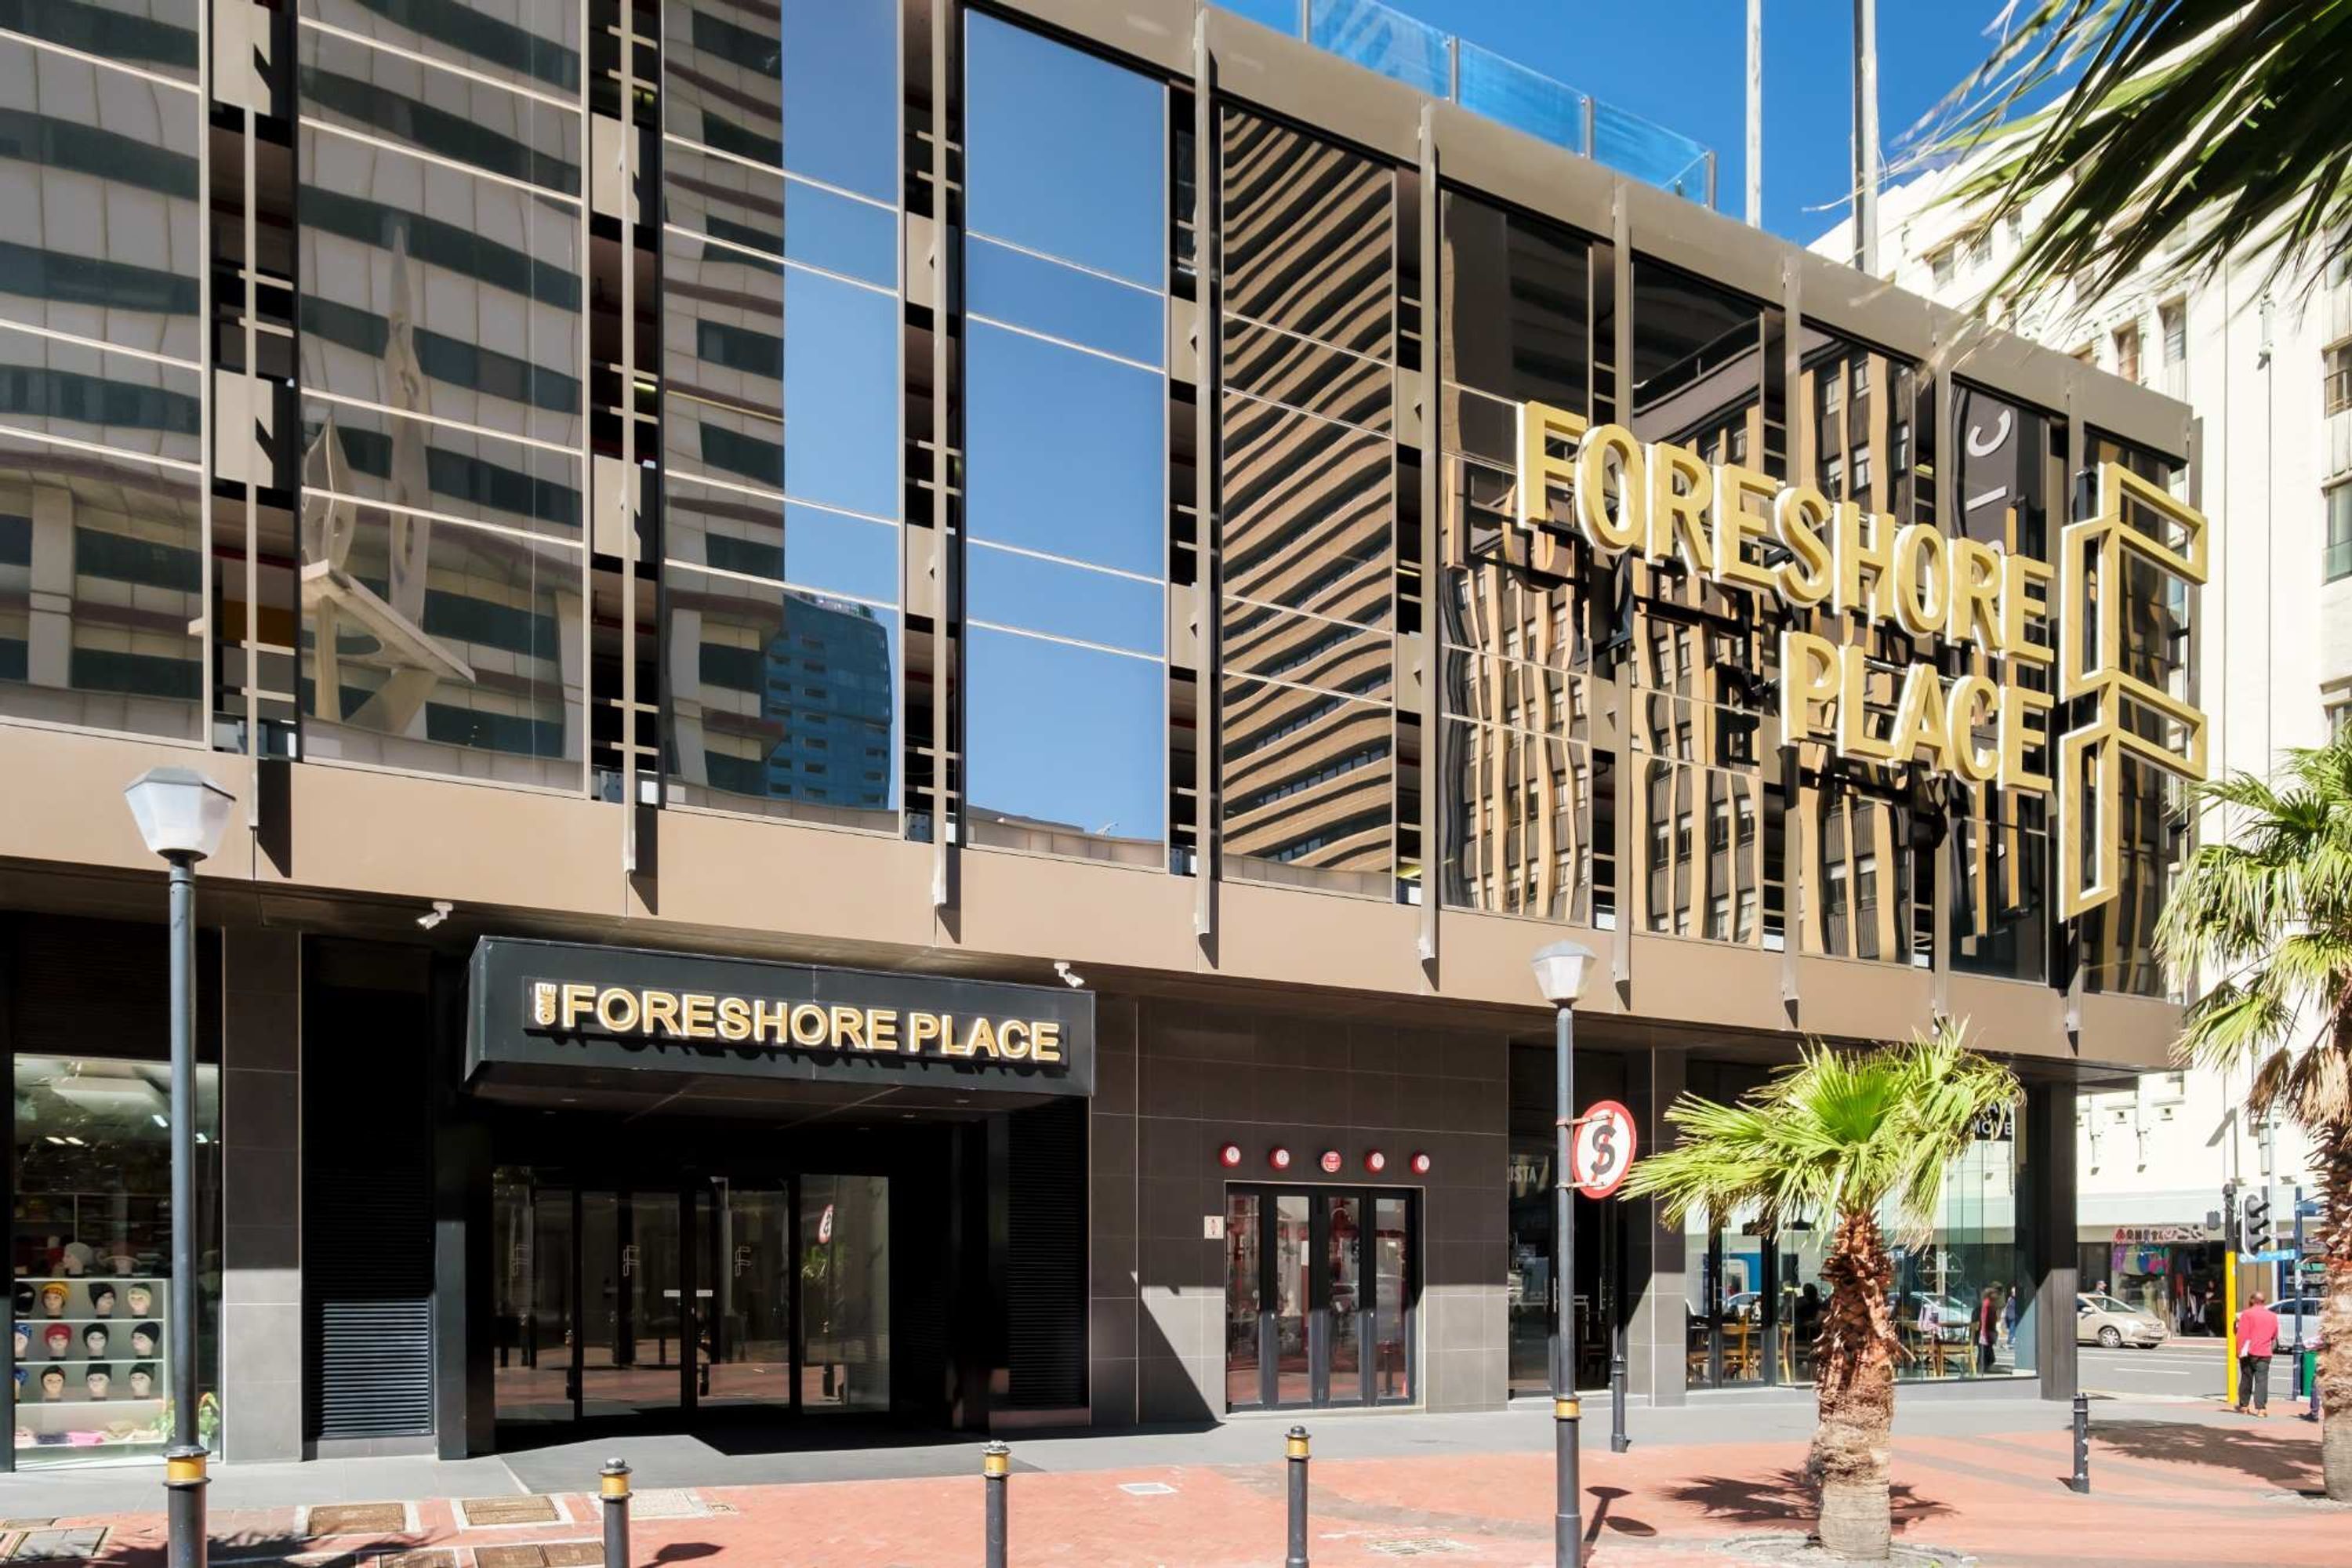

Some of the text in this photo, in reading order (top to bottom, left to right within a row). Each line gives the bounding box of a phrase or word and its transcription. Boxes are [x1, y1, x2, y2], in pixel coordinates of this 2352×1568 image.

[1516, 400, 2055, 664] FORESHORE
[1780, 630, 2055, 797] PLACE
[535, 983, 1061, 1062] ONE FORESHORE PLACE
